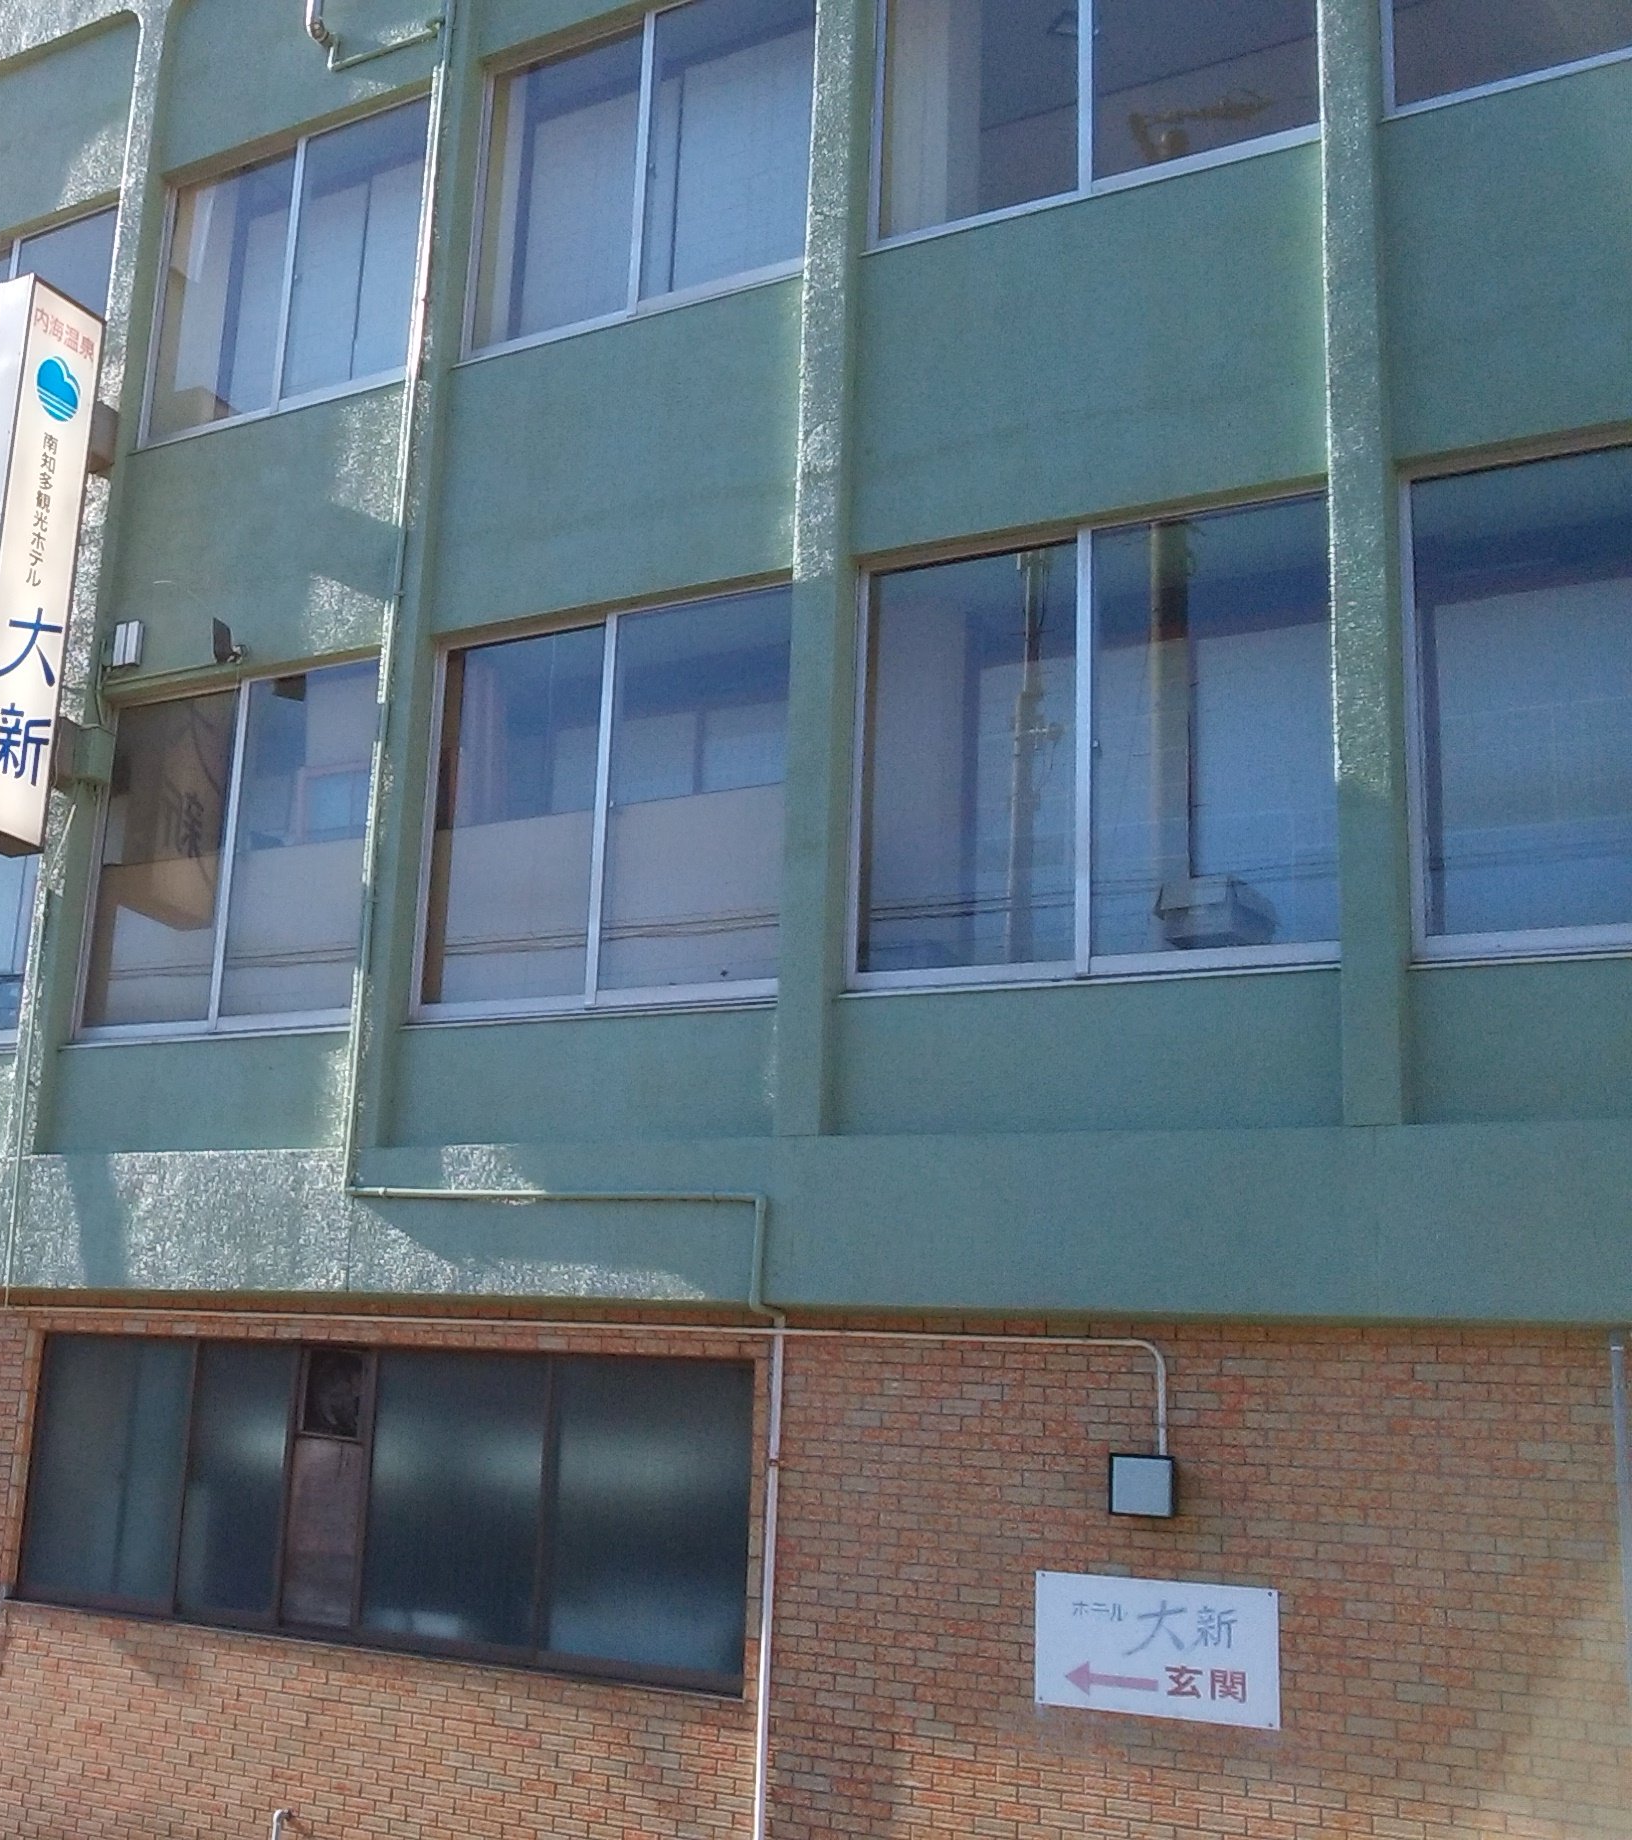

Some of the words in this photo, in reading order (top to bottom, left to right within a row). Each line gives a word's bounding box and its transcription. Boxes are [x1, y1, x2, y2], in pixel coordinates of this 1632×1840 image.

[33, 306, 96, 364] 内海温泉
[25, 431, 59, 587] 南知多観光ホテル
[1123, 1599, 1238, 1656] 大新
[1164, 1664, 1248, 1704] 玄関
